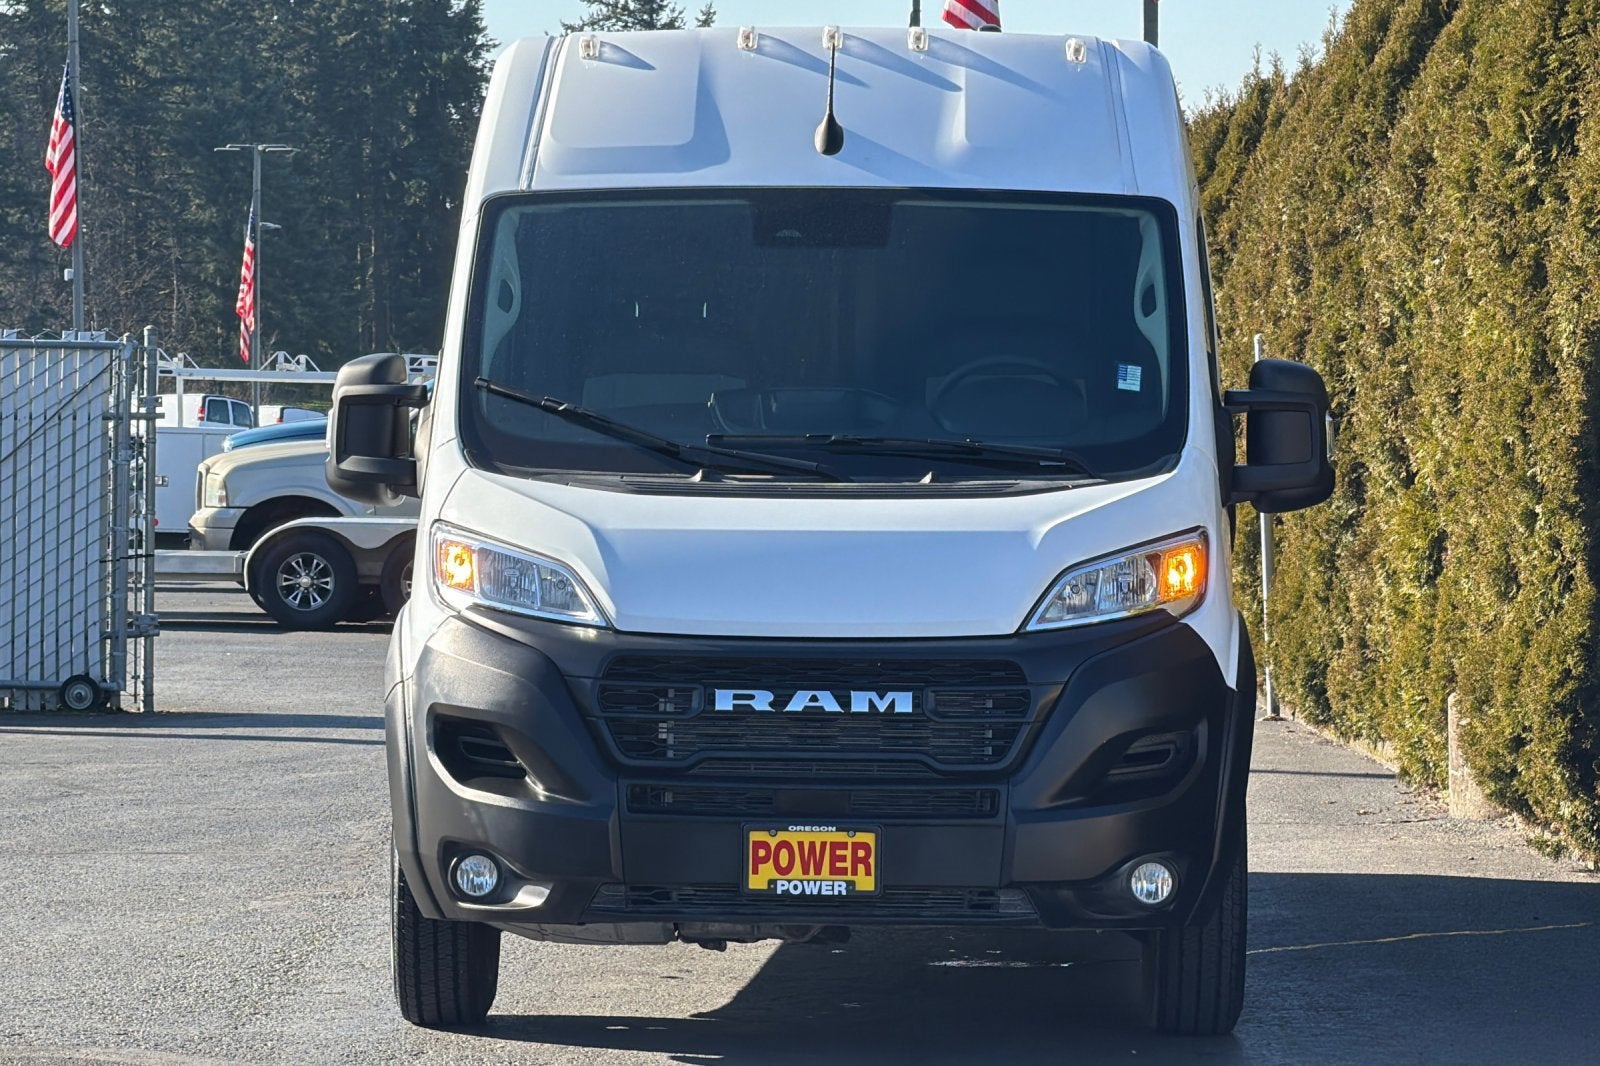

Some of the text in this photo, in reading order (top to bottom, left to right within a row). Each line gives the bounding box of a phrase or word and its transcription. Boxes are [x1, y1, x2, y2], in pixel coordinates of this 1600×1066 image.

[715, 689, 913, 713] RAM
[751, 840, 872, 877] POWER
[776, 880, 847, 896] POWER
